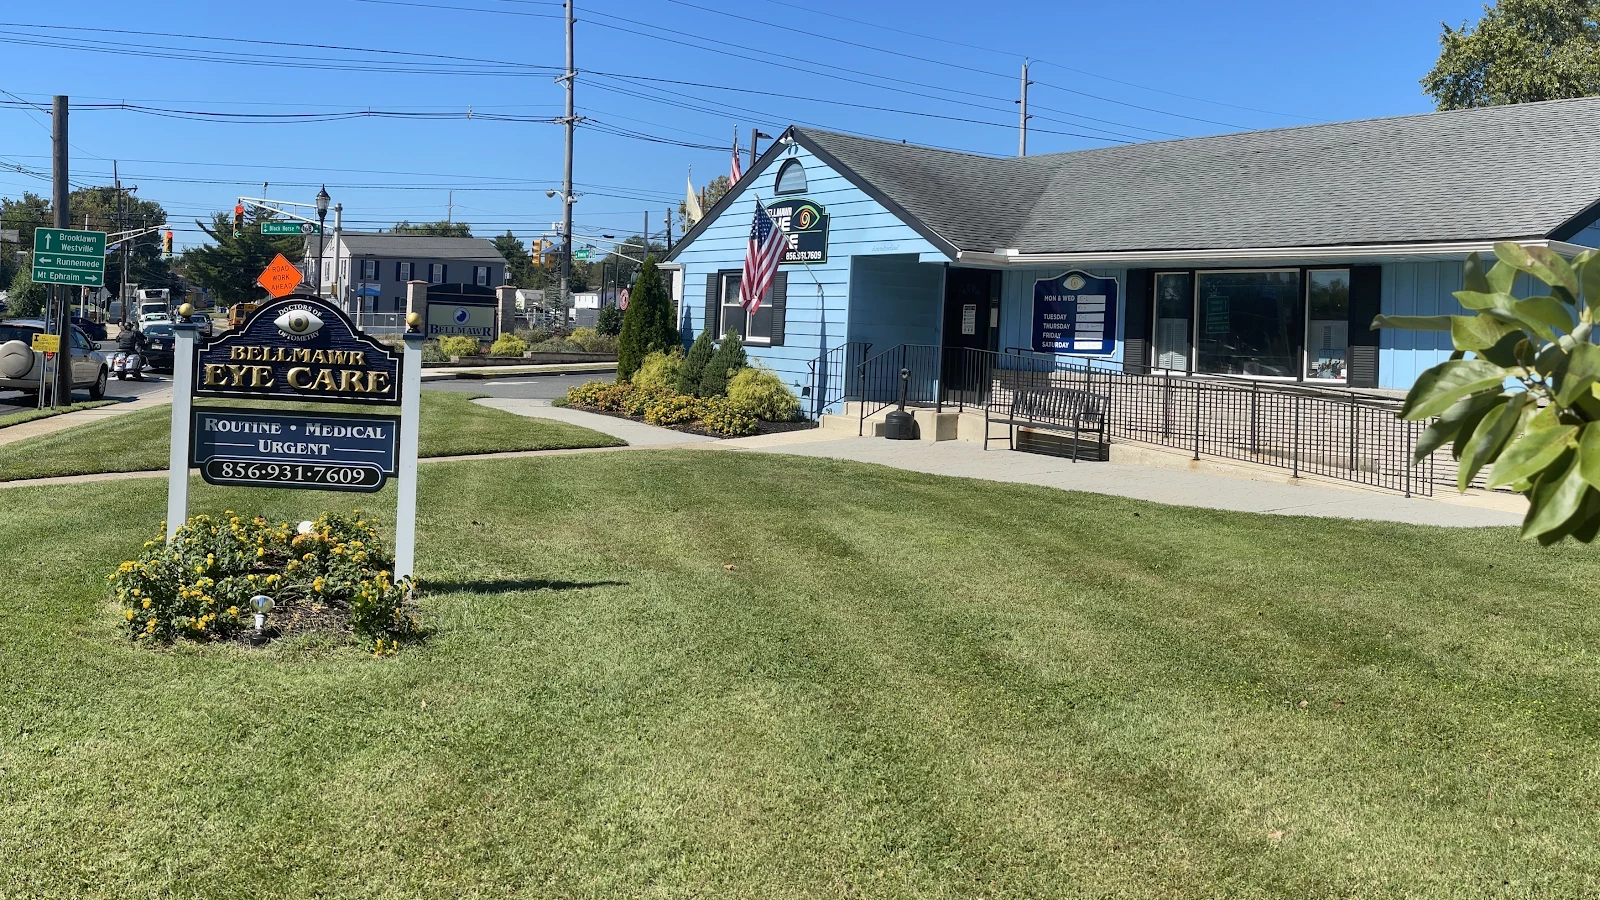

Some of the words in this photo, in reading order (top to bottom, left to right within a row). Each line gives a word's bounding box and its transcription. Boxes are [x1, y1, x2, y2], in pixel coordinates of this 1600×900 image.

[60, 233, 97, 243] Brooklawn
[61, 243, 94, 253] Westville
[56, 257, 100, 268] Runnemede
[37, 271, 47, 279] Mt
[49, 271, 80, 281] Ephraim
[278, 304, 313, 316] DOCTORS
[312, 309, 322, 317] OF
[278, 329, 320, 341] OPTOMETRY
[430, 324, 492, 336] BELLMAWR
[229, 345, 367, 366] BELLMAWR
[203, 363, 275, 388] EYE
[286, 366, 392, 394] CARE
[204, 417, 281, 435] ROUTINE
[305, 422, 386, 439] MEDICAL
[258, 439, 331, 456] URGENT
